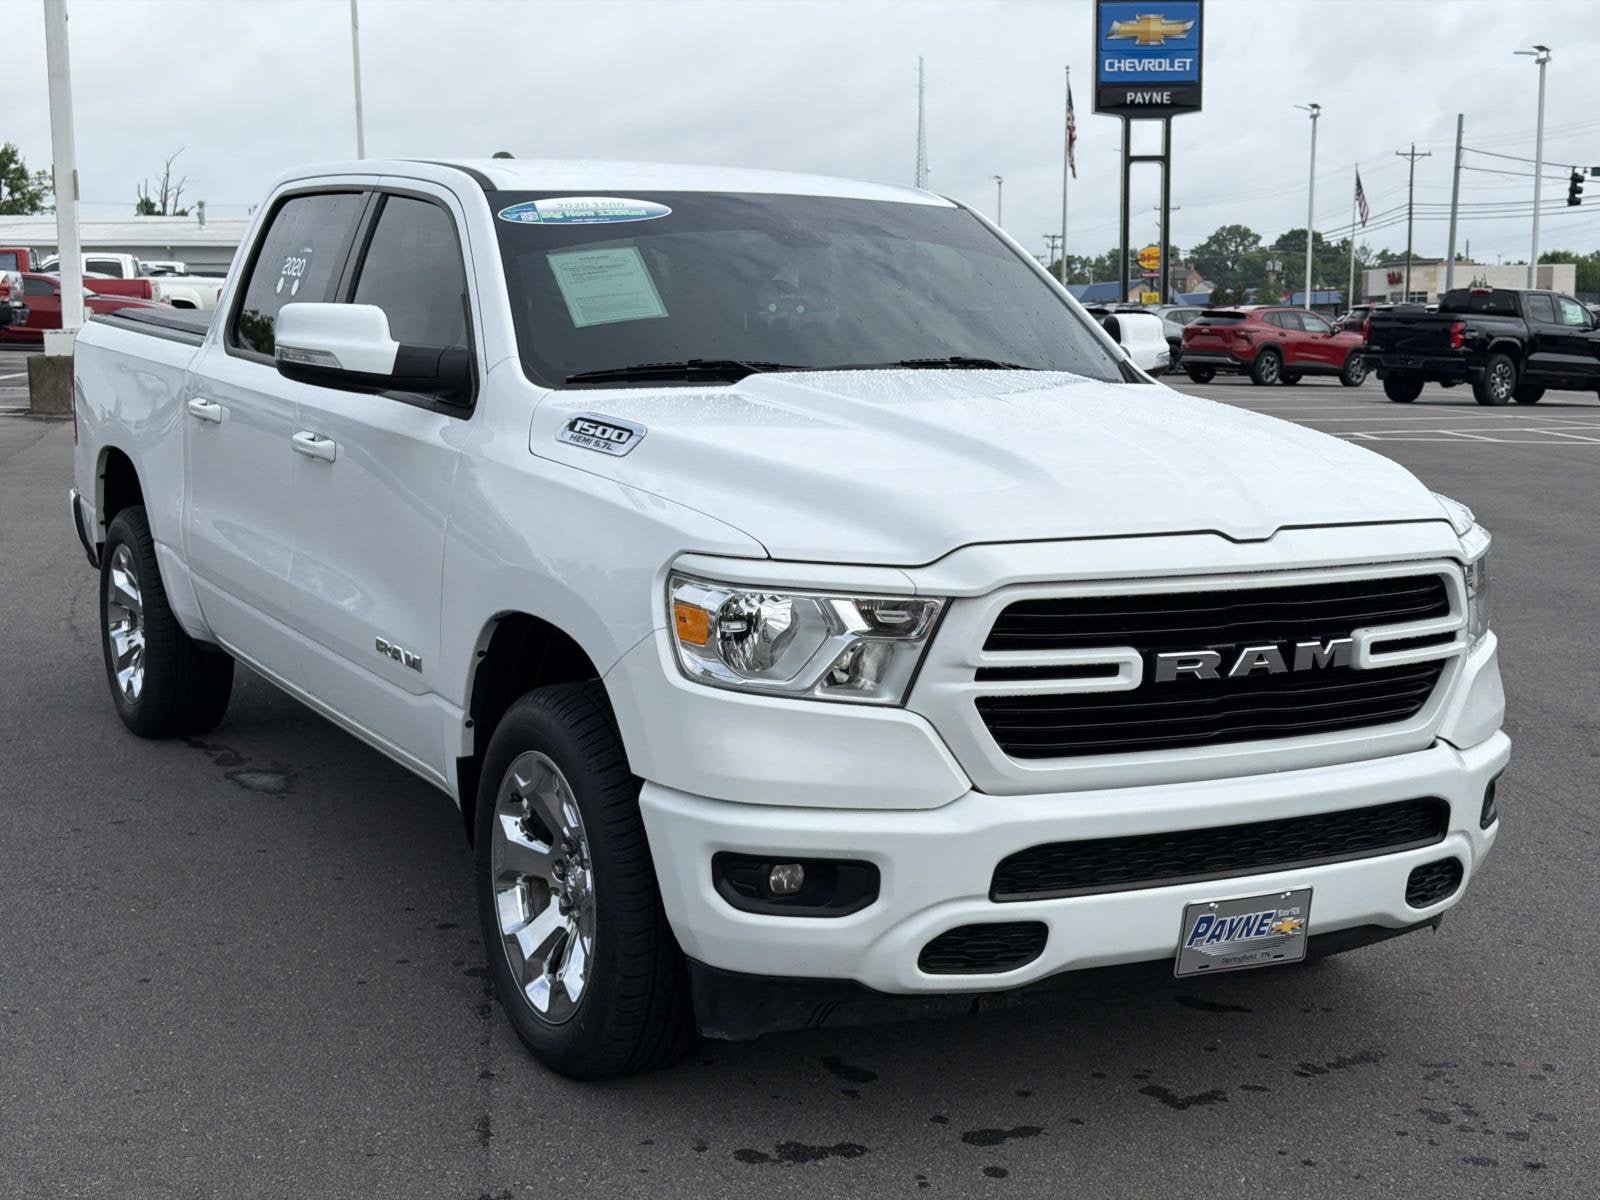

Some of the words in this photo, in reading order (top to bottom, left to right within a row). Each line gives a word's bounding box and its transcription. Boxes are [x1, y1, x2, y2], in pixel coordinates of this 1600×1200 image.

[1104, 58, 1193, 72] CHEVROLET
[1126, 91, 1172, 105] PAYNE
[282, 256, 306, 277] 2020
[569, 433, 592, 446] HEMI
[593, 439, 613, 451] 5.7L
[573, 419, 631, 443] 1500
[375, 636, 423, 674] RAM
[1155, 638, 1354, 683] RAM
[1184, 909, 1277, 949] PAYNE
